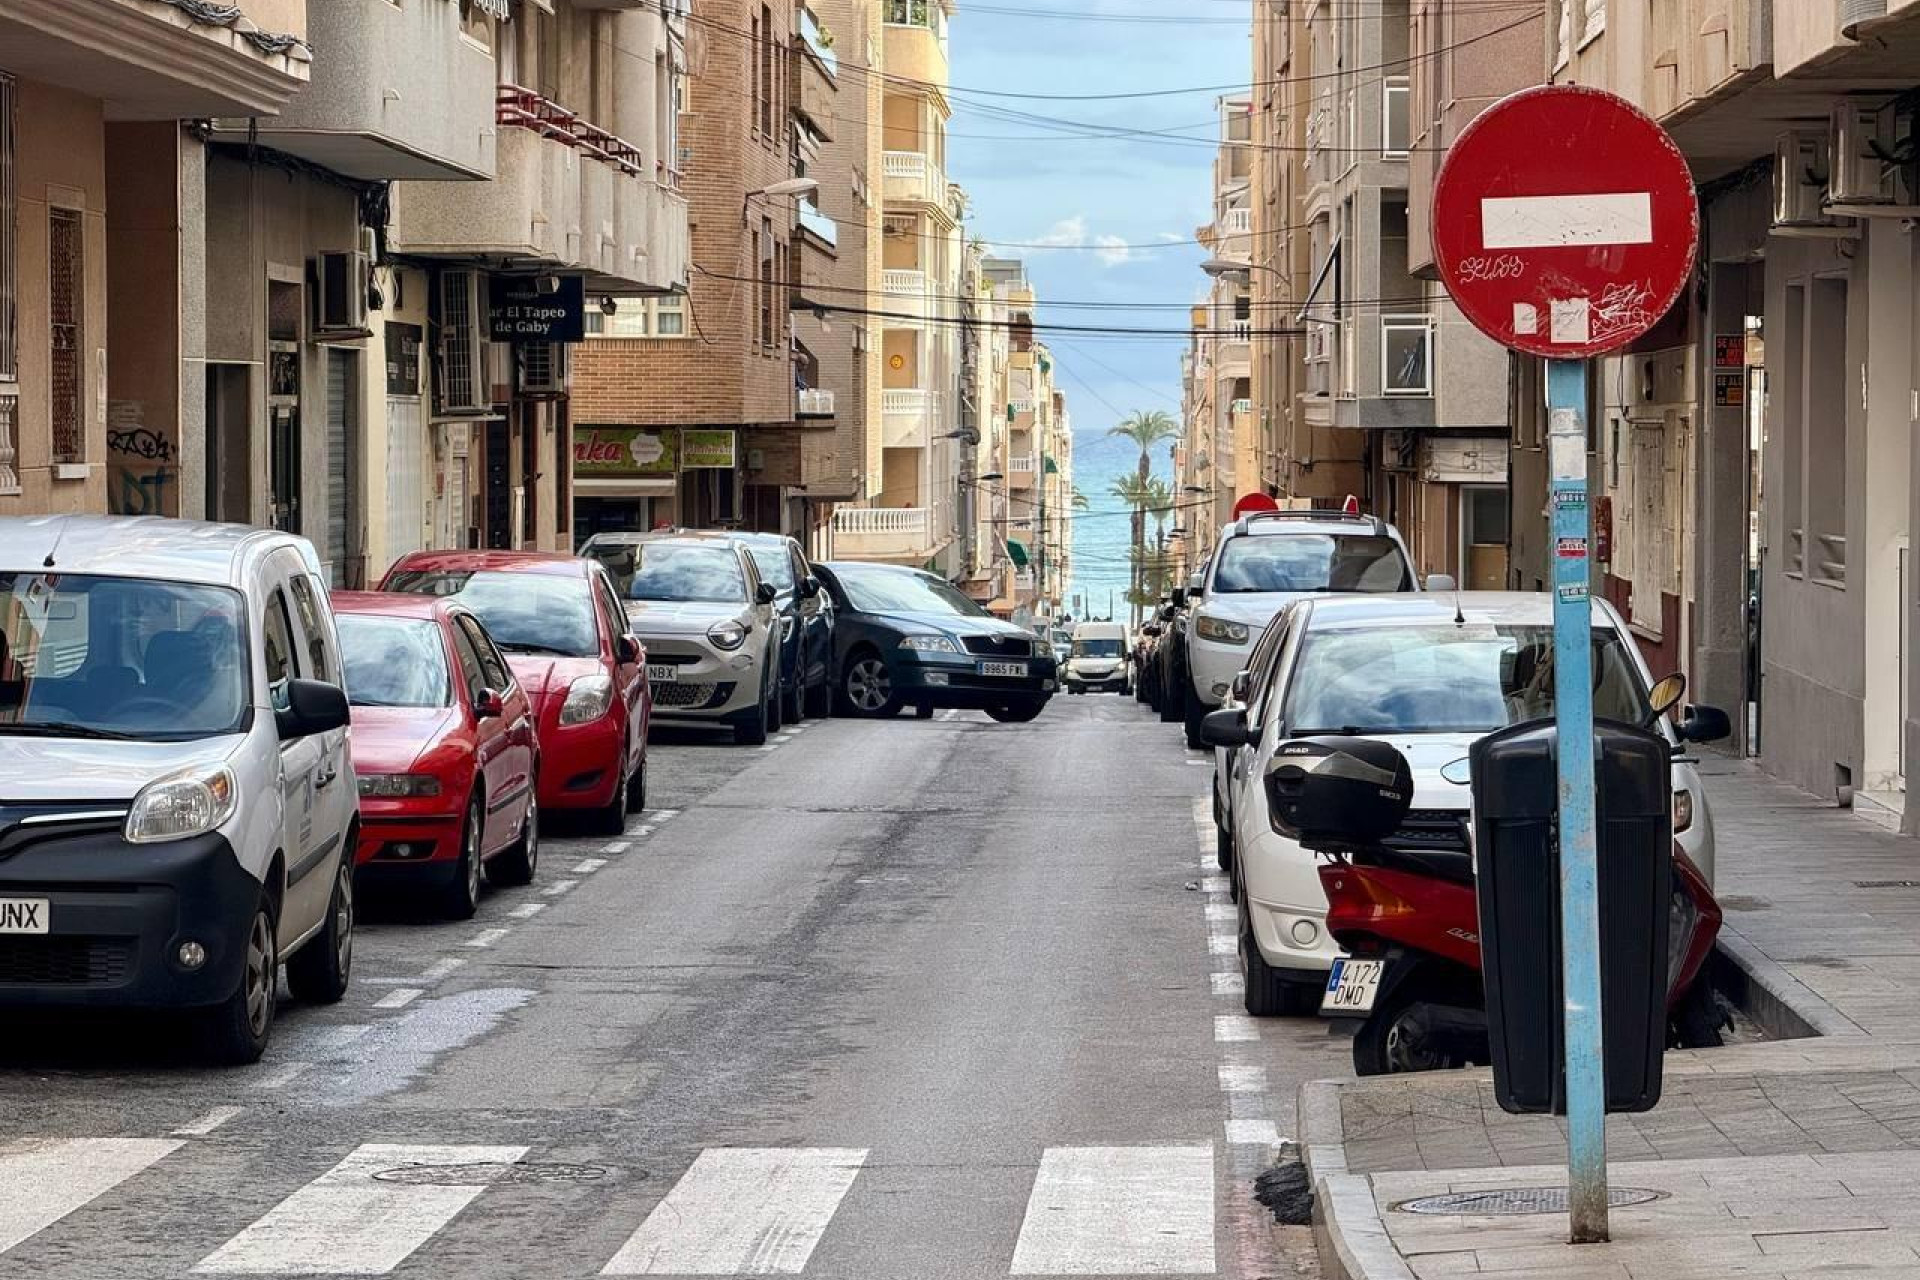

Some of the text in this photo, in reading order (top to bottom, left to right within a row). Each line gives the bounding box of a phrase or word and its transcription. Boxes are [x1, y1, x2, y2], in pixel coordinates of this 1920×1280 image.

[507, 307, 519, 317] El
[523, 307, 566, 320] Tapeo
[495, 320, 550, 335] de Gaby
[649, 666, 673, 679] NBX
[1341, 963, 1381, 985] 4172
[1334, 985, 1365, 1005] DMD
